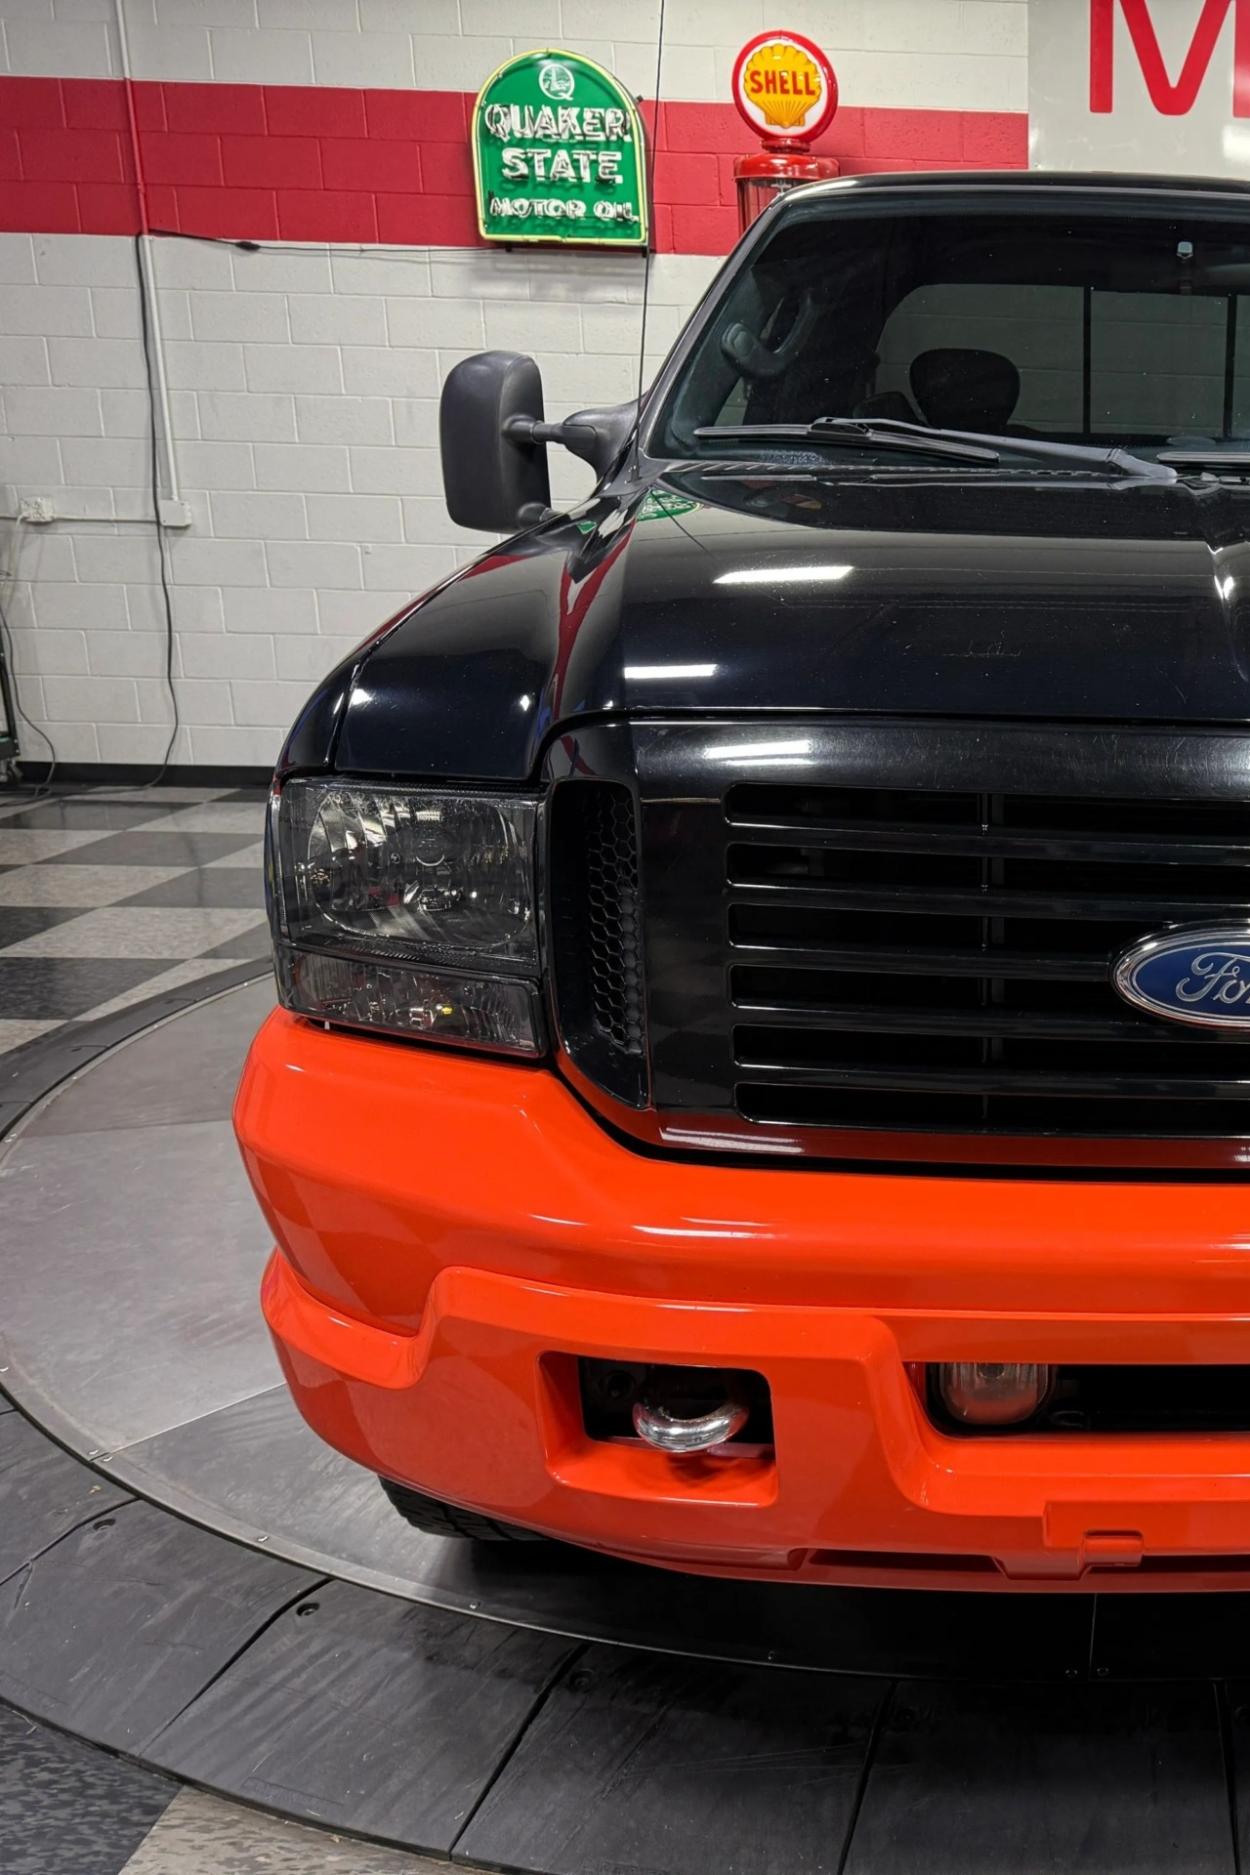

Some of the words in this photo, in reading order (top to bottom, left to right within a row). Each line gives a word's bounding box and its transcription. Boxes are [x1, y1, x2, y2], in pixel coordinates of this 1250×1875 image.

[750, 69, 816, 96] SHELL
[485, 104, 632, 141] QUAKER
[501, 147, 623, 184] STATE
[489, 197, 587, 220] MOTOR
[593, 198, 640, 222] OIL
